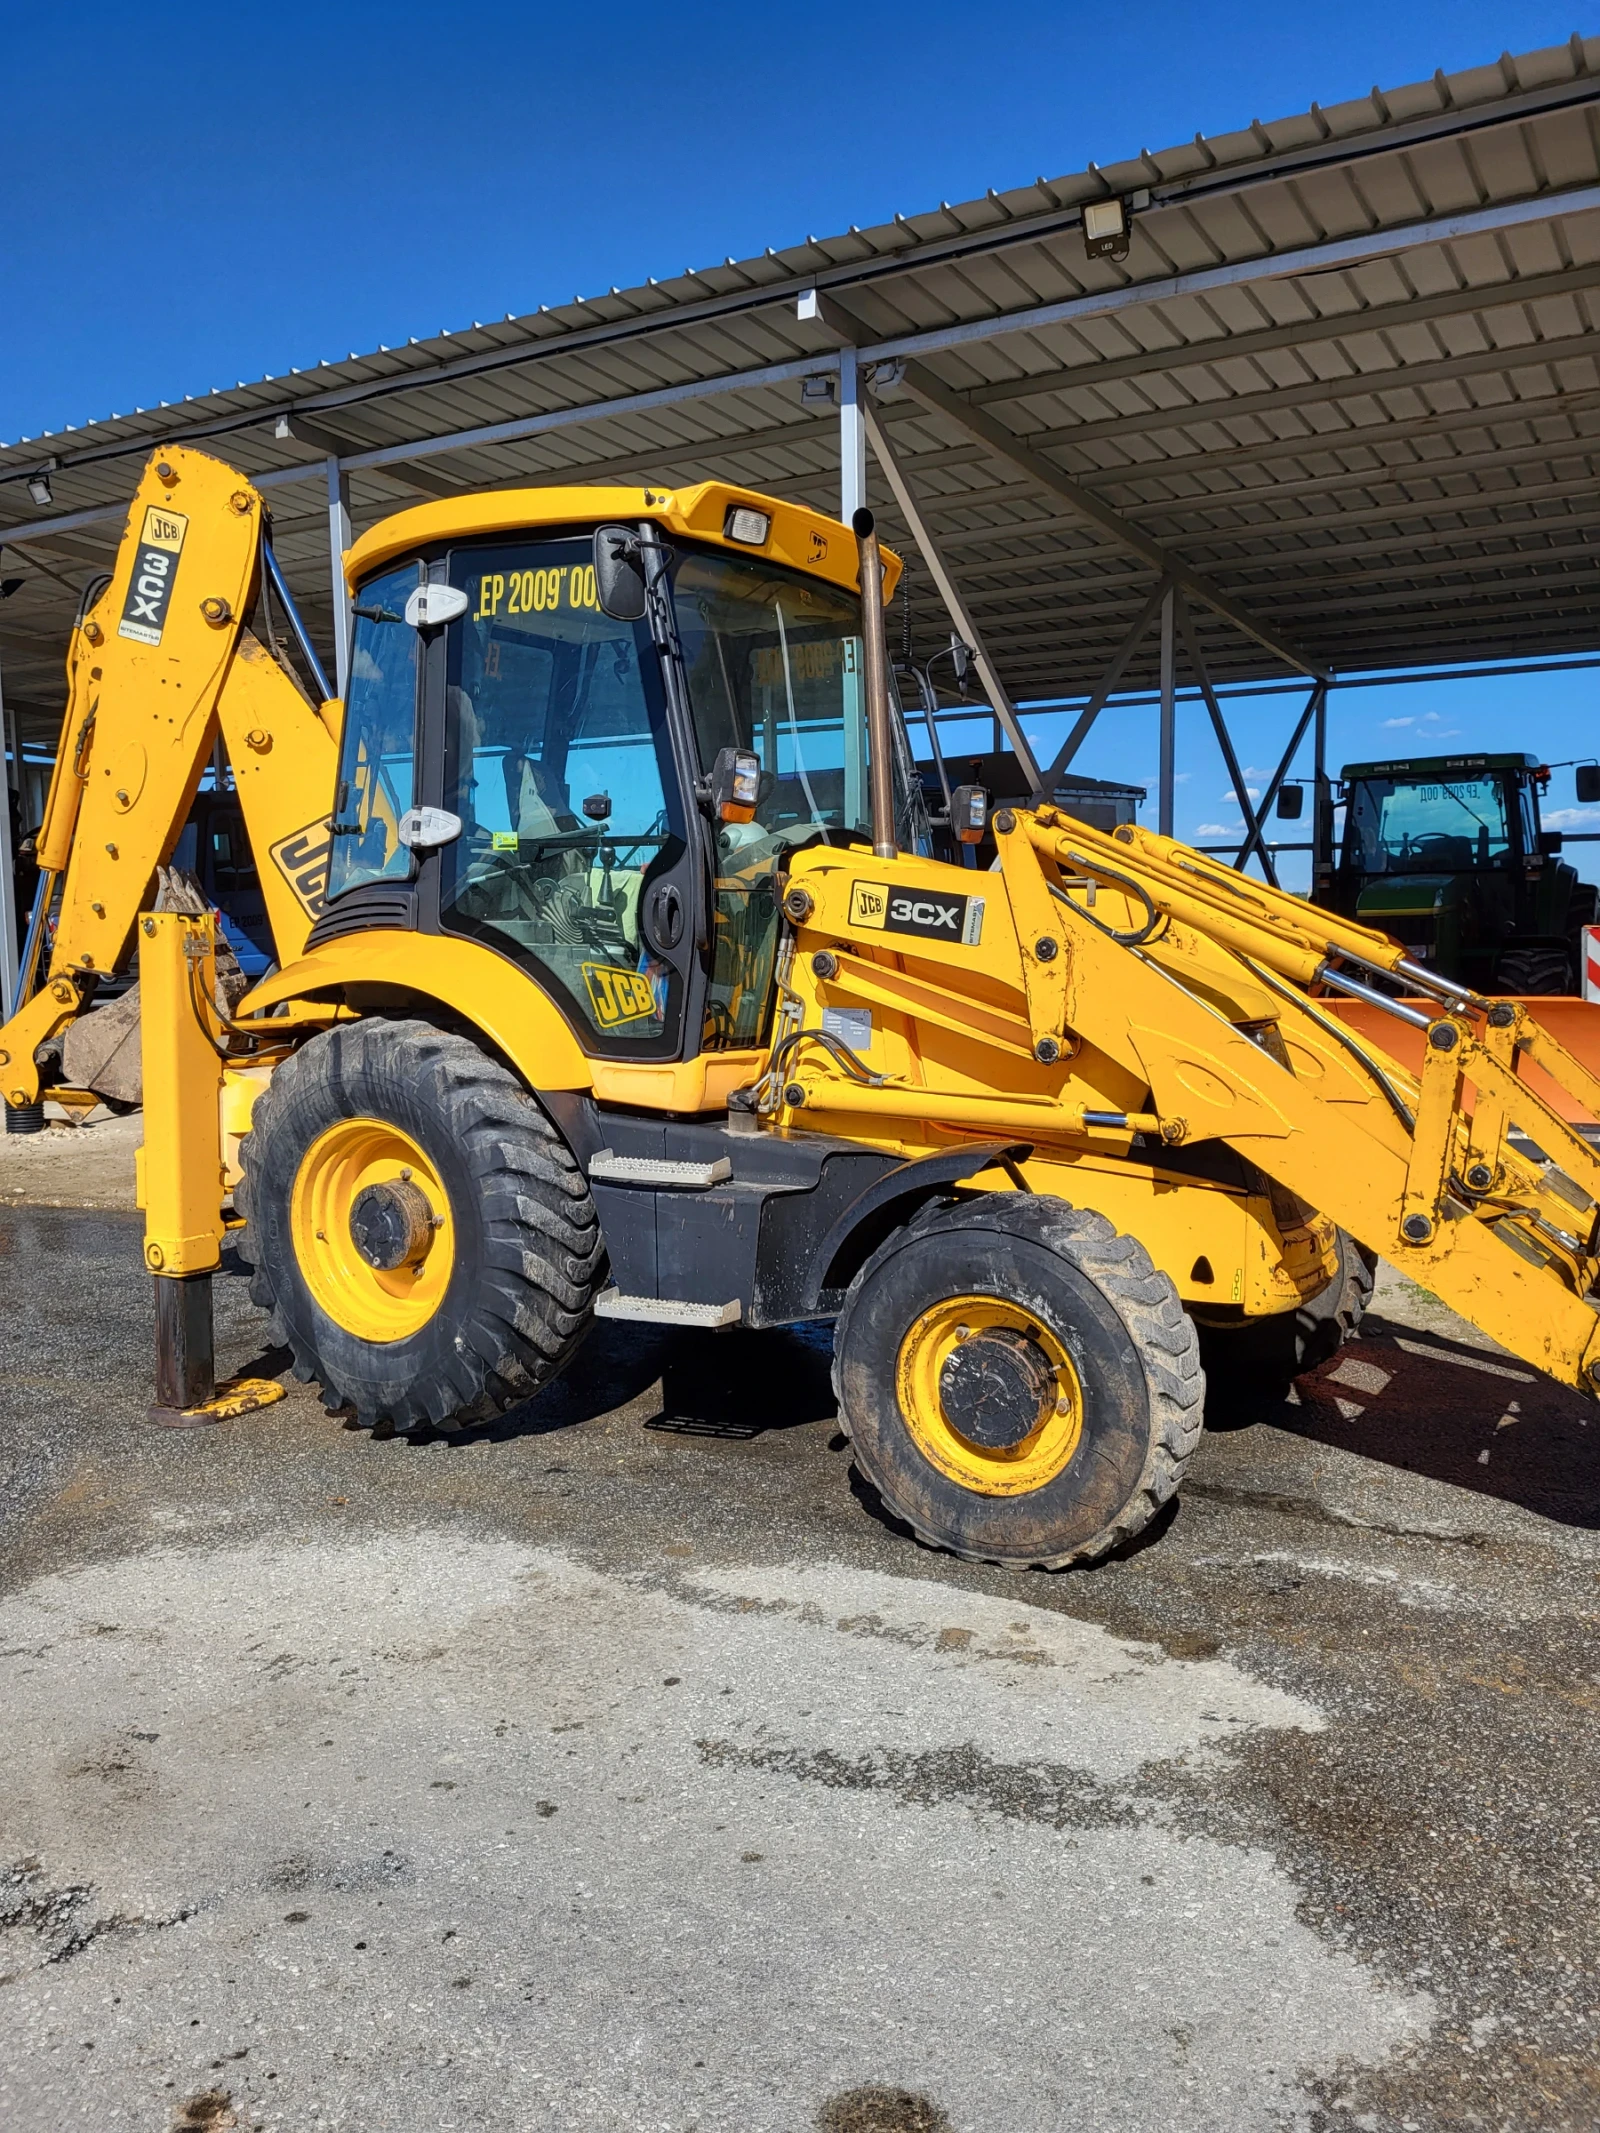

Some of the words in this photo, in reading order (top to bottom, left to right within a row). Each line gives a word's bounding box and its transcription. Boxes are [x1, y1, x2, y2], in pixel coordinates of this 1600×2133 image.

[1101, 242, 1113, 251] LED
[154, 518, 178, 539] JCB
[129, 552, 170, 623] 3CX
[859, 892, 882, 915] JCB
[890, 898, 960, 930] 3CX
[595, 969, 652, 1021] JCB
